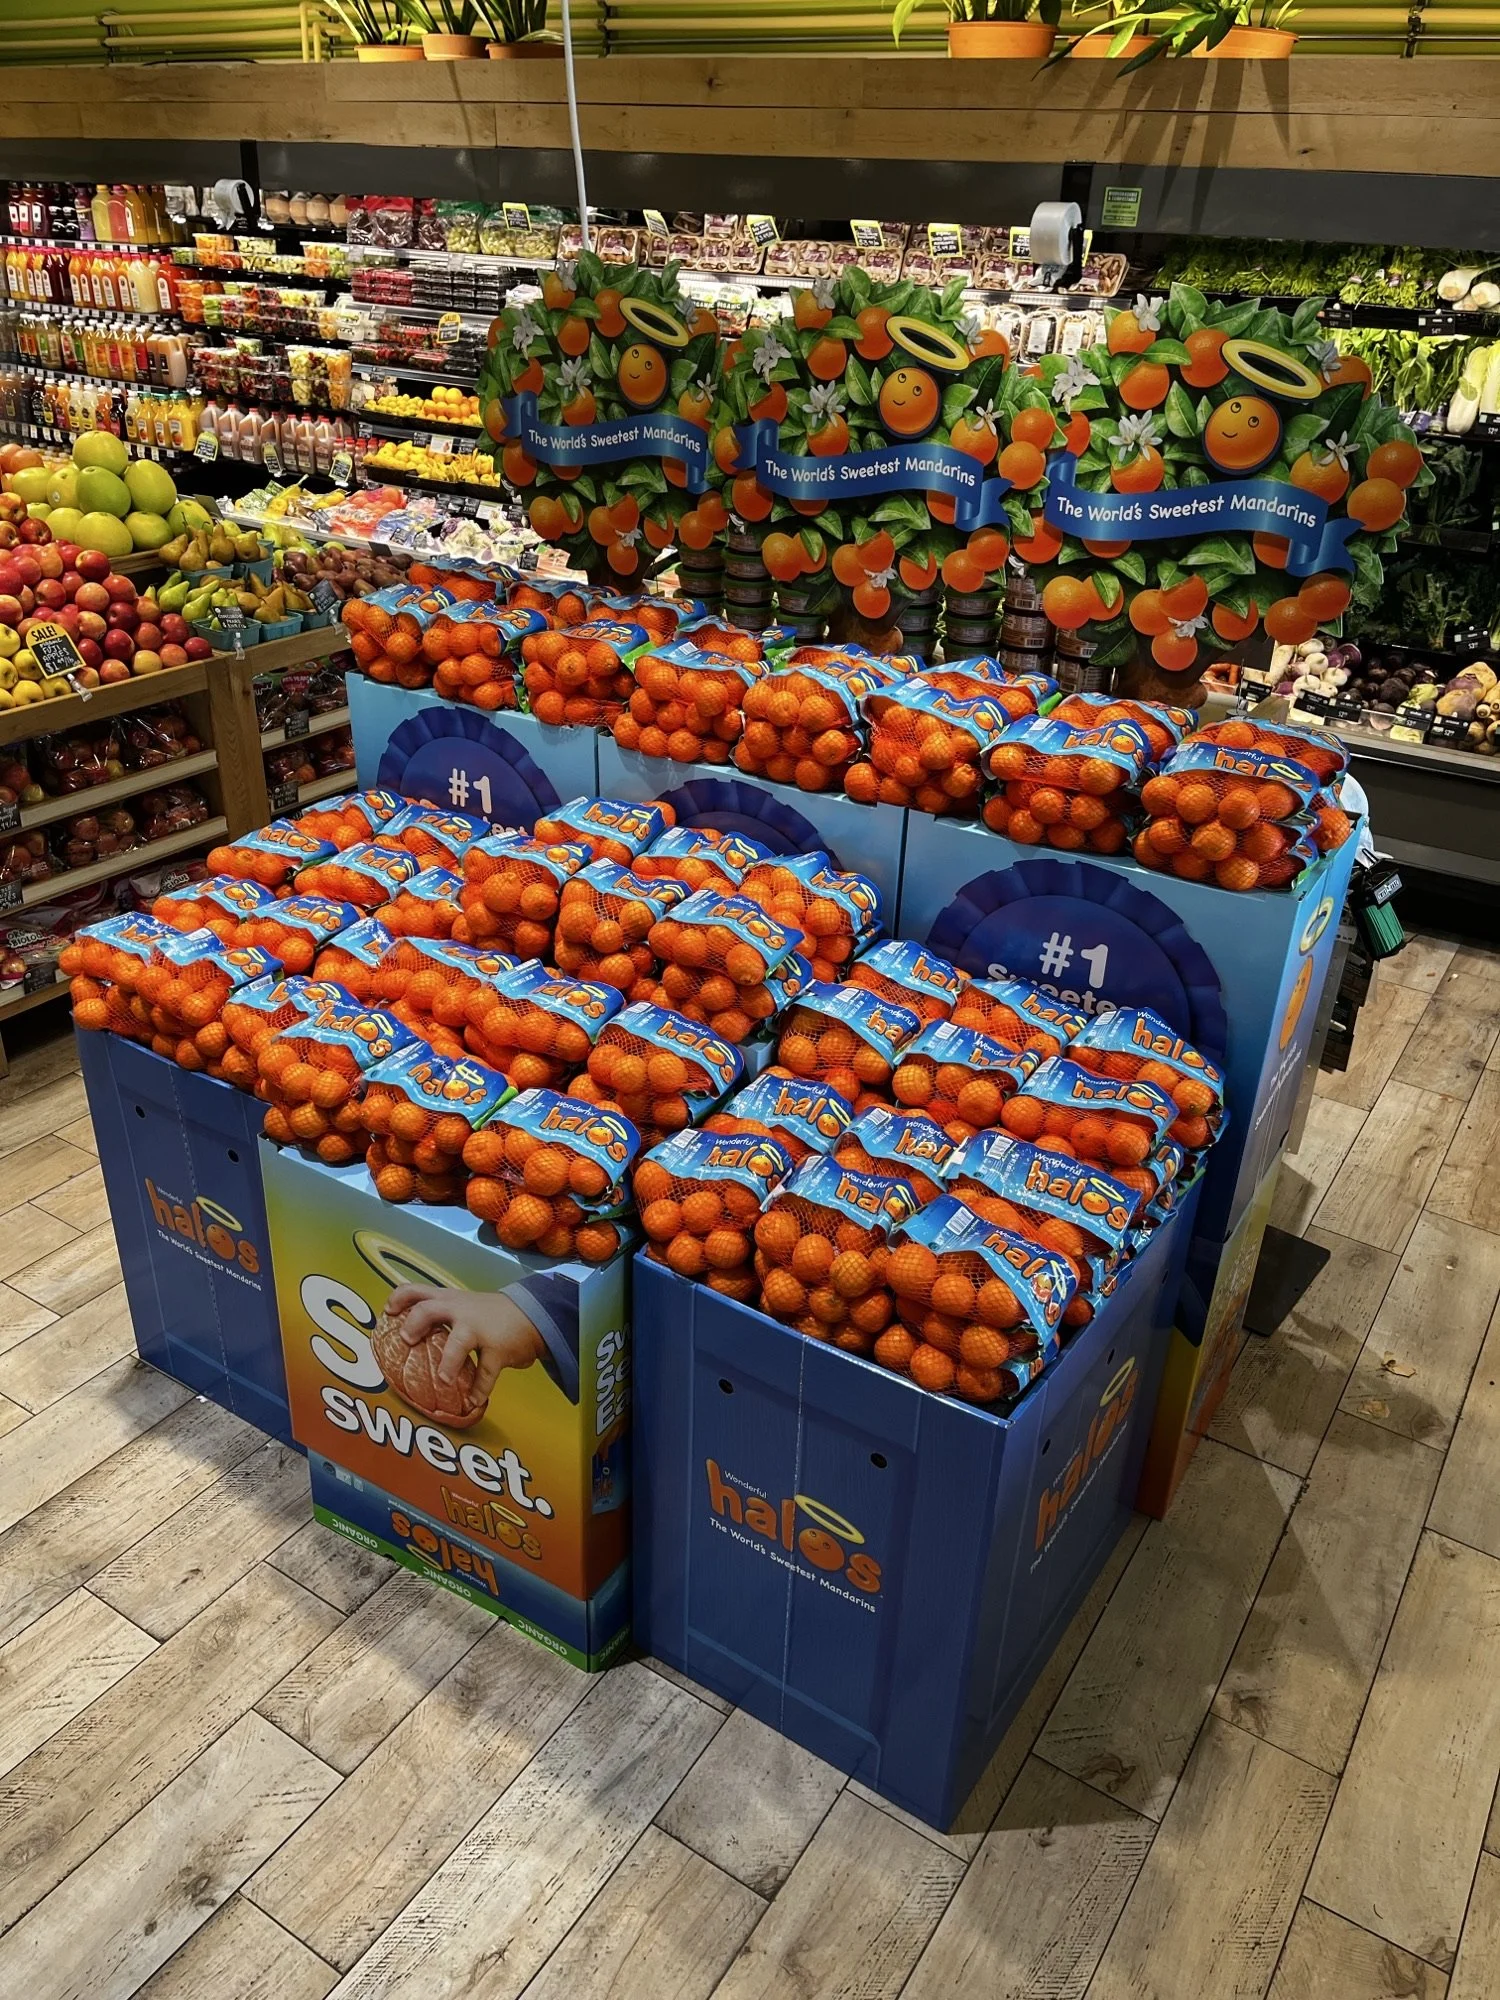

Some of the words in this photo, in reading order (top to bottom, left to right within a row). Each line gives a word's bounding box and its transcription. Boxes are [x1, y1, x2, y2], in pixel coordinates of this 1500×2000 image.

[528, 429, 548, 447] The
[549, 433, 587, 450] World's
[591, 427, 639, 447] Sweetest
[643, 426, 701, 453] Mandarins
[765, 459, 788, 479] The
[791, 464, 835, 482] World's
[840, 457, 900, 480] Sweetest
[905, 456, 975, 487] Mandarins
[1057, 496, 1083, 518] The
[1087, 502, 1142, 522] World's
[1149, 495, 1225, 520] Sweetest
[1230, 494, 1316, 528] Mandarins
[31, 625, 57, 641] SALE!
[42, 644, 60, 654] FUJI
[42, 647, 70, 662] APPLES
[1063, 727, 1145, 769] halos
[448, 768, 493, 814] #1
[257, 826, 321, 852] halos
[583, 803, 650, 841] halos
[355, 849, 408, 882] halo
[810, 870, 872, 926] halos
[118, 923, 164, 944] hal
[706, 902, 785, 950] halos
[912, 956, 958, 992] hal
[1039, 932, 1108, 989] #1
[314, 1006, 392, 1058] halos
[667, 1013, 709, 1036] Wonderful
[874, 1001, 916, 1029] Wonderful
[1020, 993, 1081, 1041] halo
[656, 1020, 734, 1084] halos
[1132, 1017, 1220, 1083] halos
[407, 1061, 488, 1105] halos
[783, 1080, 825, 1095] Wonderful
[1071, 1080, 1169, 1120] halos
[773, 1087, 840, 1138] halo
[906, 1121, 947, 1141] Wonderful
[540, 1106, 627, 1163] halos
[715, 1137, 755, 1147] Wonderful
[895, 1128, 952, 1164] hal
[842, 1171, 889, 1189] Wonderful
[1034, 1151, 1084, 1177] Wonderful
[835, 1176, 907, 1221] halo
[1024, 1158, 1130, 1230] halos
[145, 1178, 260, 1274] halos
[995, 1229, 1047, 1255] Wonderful
[157, 1229, 169, 1242] The
[170, 1238, 193, 1255] World's
[194, 1251, 224, 1272] Sweetest
[225, 1267, 261, 1291] Mandarins
[982, 1232, 1061, 1328] halos
[320, 1386, 555, 1520] sweet.
[1035, 1368, 1139, 1551] halos
[725, 1471, 767, 1499] Wonderful
[332, 1518, 378, 1549] ORGANIC
[440, 1485, 543, 1561] halos
[706, 1458, 882, 1593] halos
[391, 1511, 499, 1597] halos
[709, 1517, 728, 1534] The
[730, 1528, 766, 1555] World's
[770, 1551, 816, 1582] Sweetest
[820, 1578, 876, 1613] Mandarins
[423, 1566, 472, 1598] ORGANIC
[517, 1619, 569, 1656] ORGANIC
